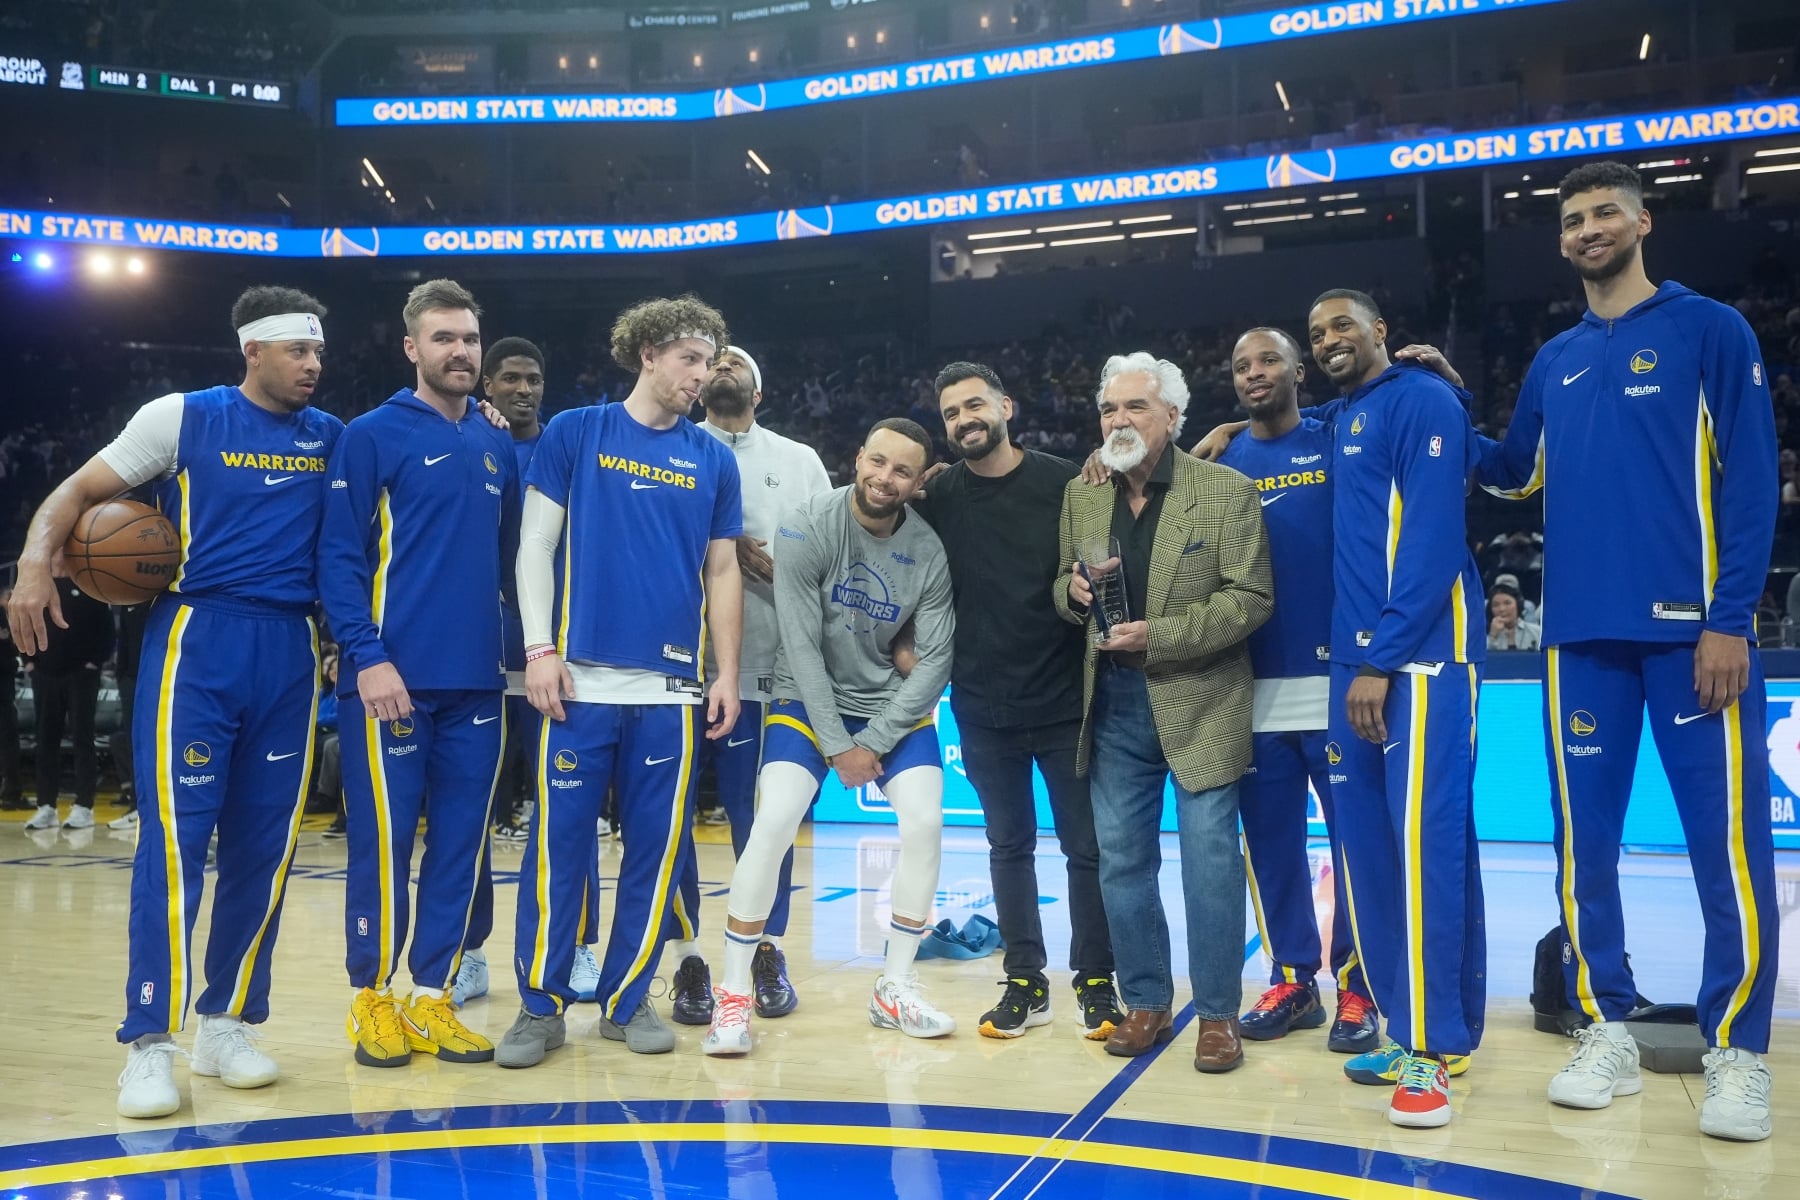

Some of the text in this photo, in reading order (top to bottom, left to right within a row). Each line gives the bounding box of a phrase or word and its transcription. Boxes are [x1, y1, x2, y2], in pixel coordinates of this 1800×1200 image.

[644, 15, 717, 25] CHASE CENTER
[1270, 0, 1383, 36] GOLDEN
[804, 38, 1116, 99] GOLDEN STATE WARRIORS
[100, 70, 129, 86] MIN
[137, 73, 147, 89] 2
[170, 77, 199, 93] DAL
[207, 80, 215, 95] 1
[373, 98, 677, 121] GOLDEN STATE WARRIORS
[1390, 103, 1800, 169] GOLDEN STATE WARRIOR
[875, 167, 1217, 224] GOLDEN STATE WARRIORS
[42, 216, 124, 241] STATE
[135, 222, 279, 252] WARRIORS
[423, 220, 738, 251] GOLDEN STATE WARRIORS
[1624, 385, 1661, 396] Rakuten
[220, 451, 326, 472] WARRIORS
[668, 456, 697, 469] Rakuten
[1291, 454, 1322, 465] Rakuten
[598, 453, 696, 490] WARRIORS
[1567, 744, 1602, 757] Rakuten
[179, 775, 215, 786] Rakuten
[551, 778, 583, 789] Rakuten
